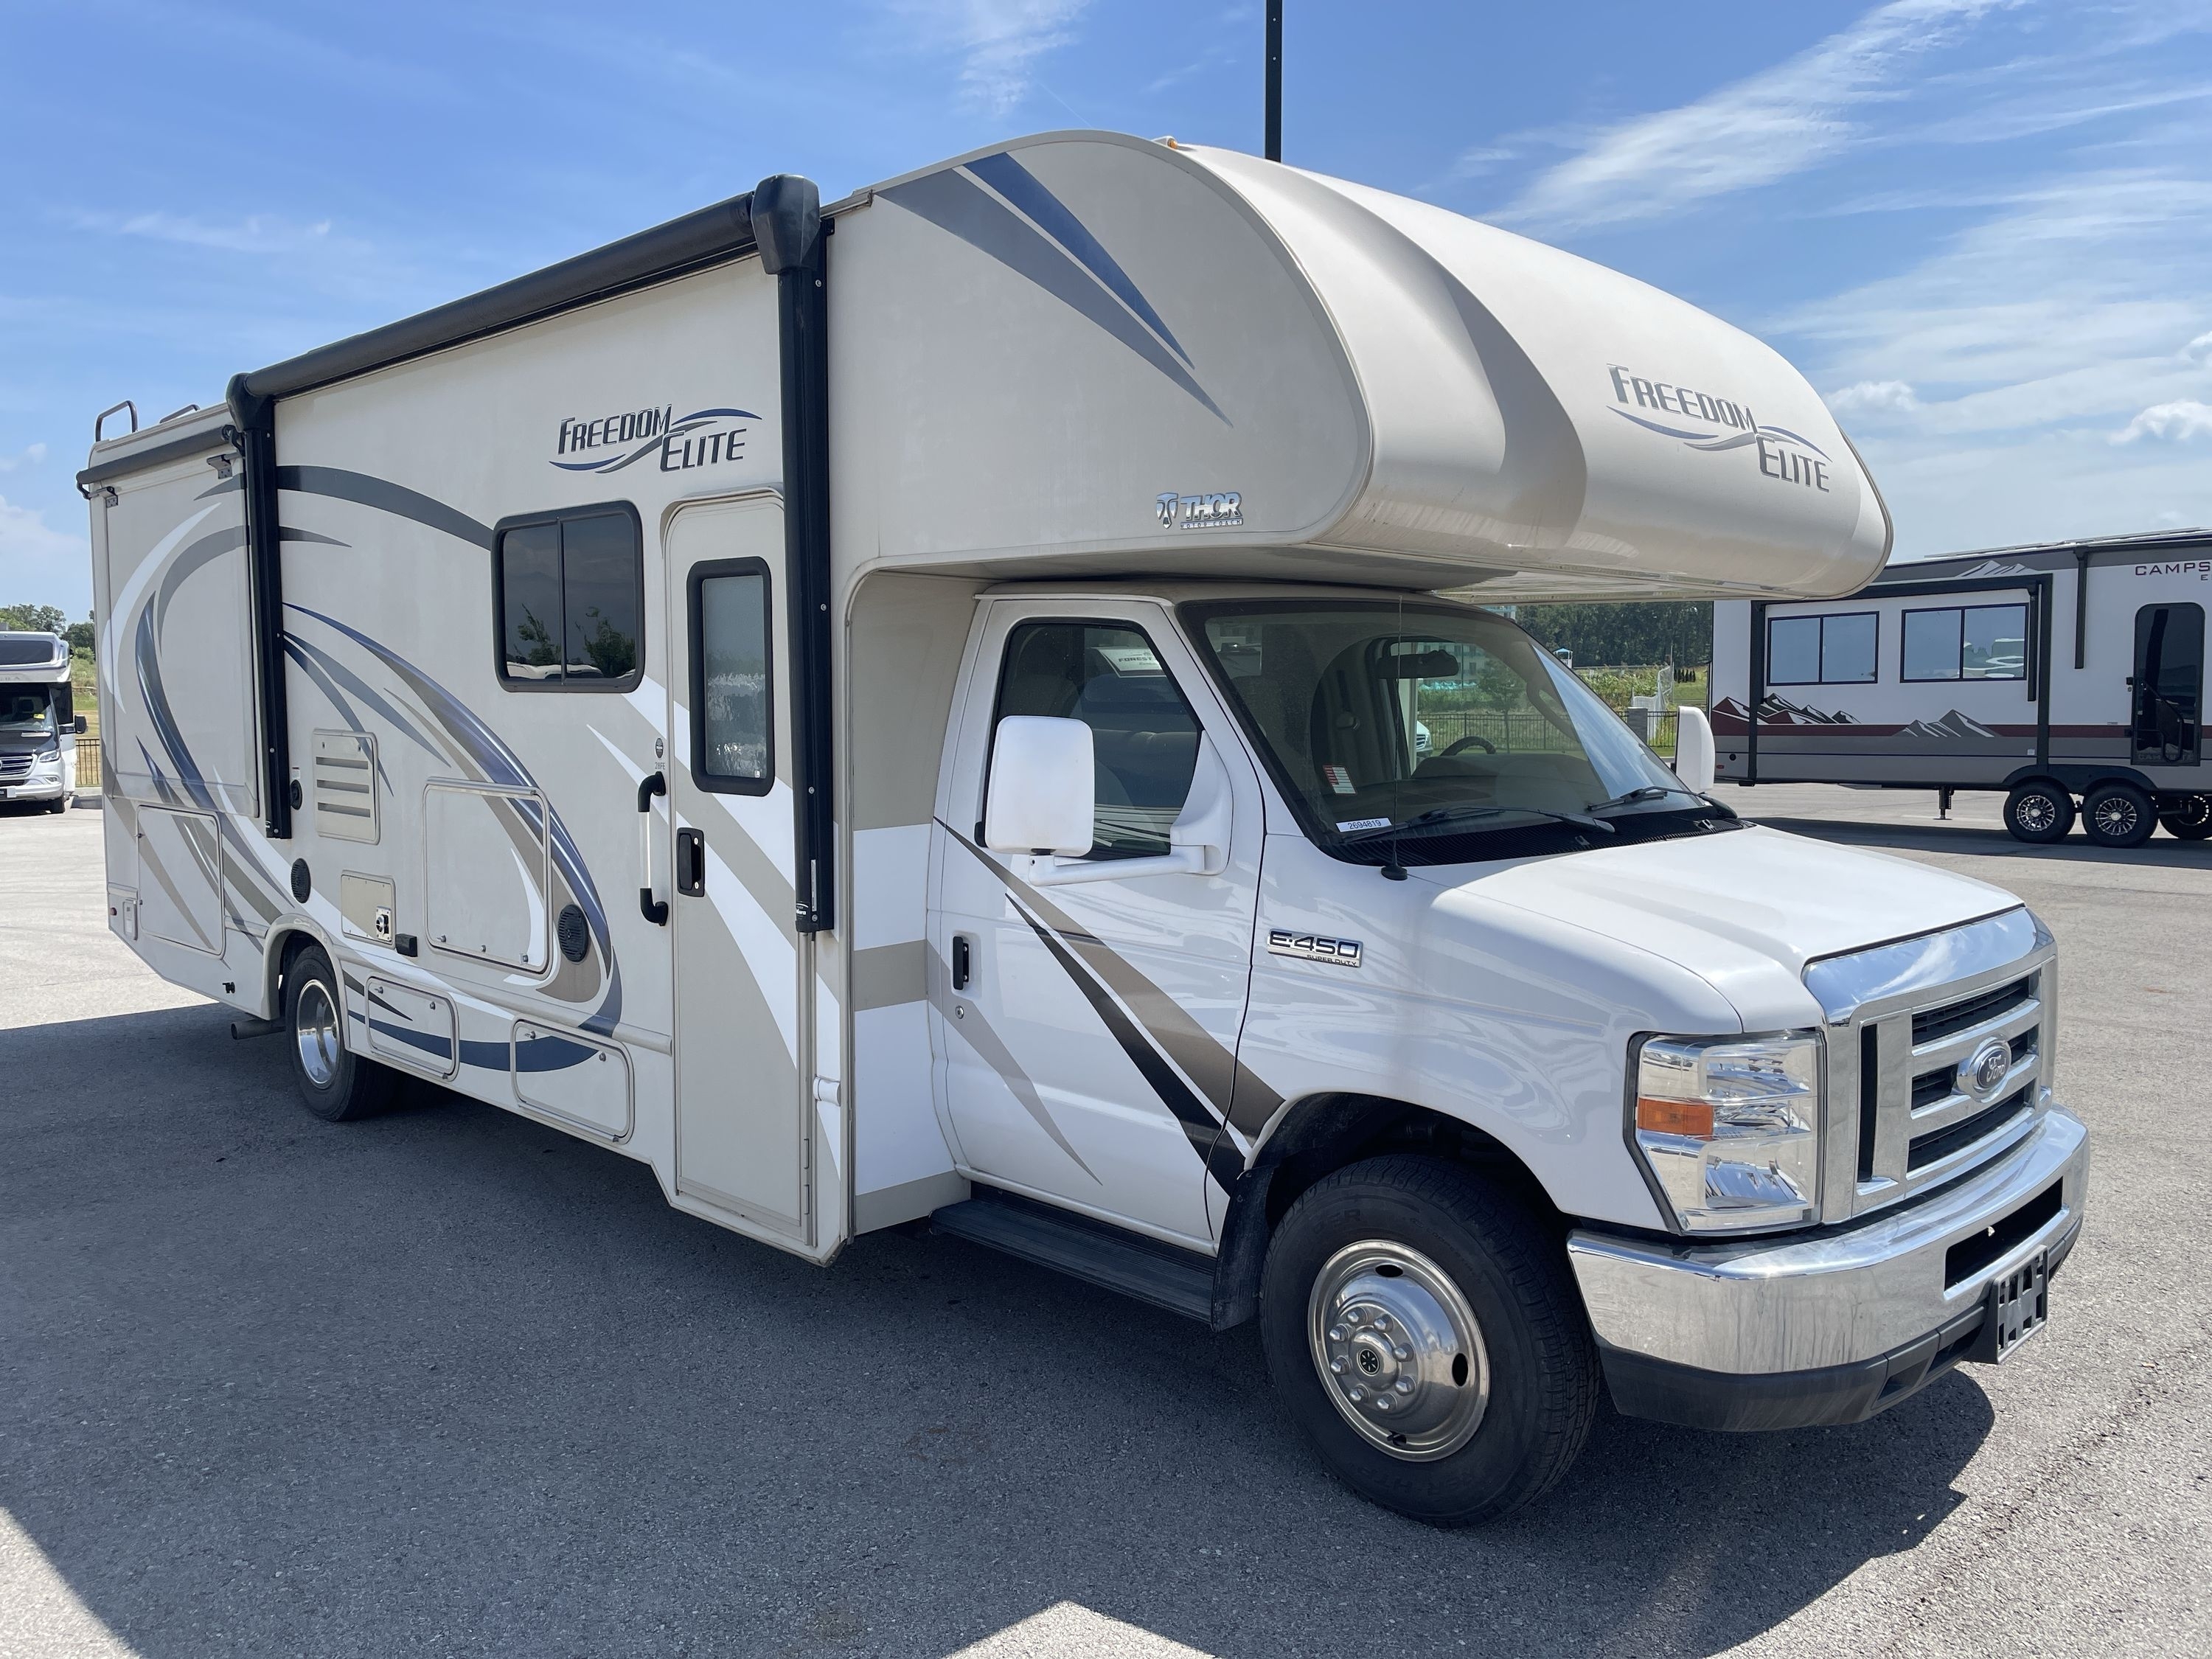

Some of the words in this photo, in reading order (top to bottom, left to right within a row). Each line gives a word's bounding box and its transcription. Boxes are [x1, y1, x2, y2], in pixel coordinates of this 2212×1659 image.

[1606, 363, 1758, 434] FREEDOM
[557, 404, 672, 455] FREEDOM
[659, 428, 747, 473] ELITE
[1755, 434, 1829, 493] ELITE
[1180, 492, 1242, 521] THOR
[1347, 819, 1382, 830] 2694819
[1307, 954, 1332, 963] SUPER
[1335, 959, 1357, 967] DUTY
[1986, 1054, 2007, 1082] Ford
